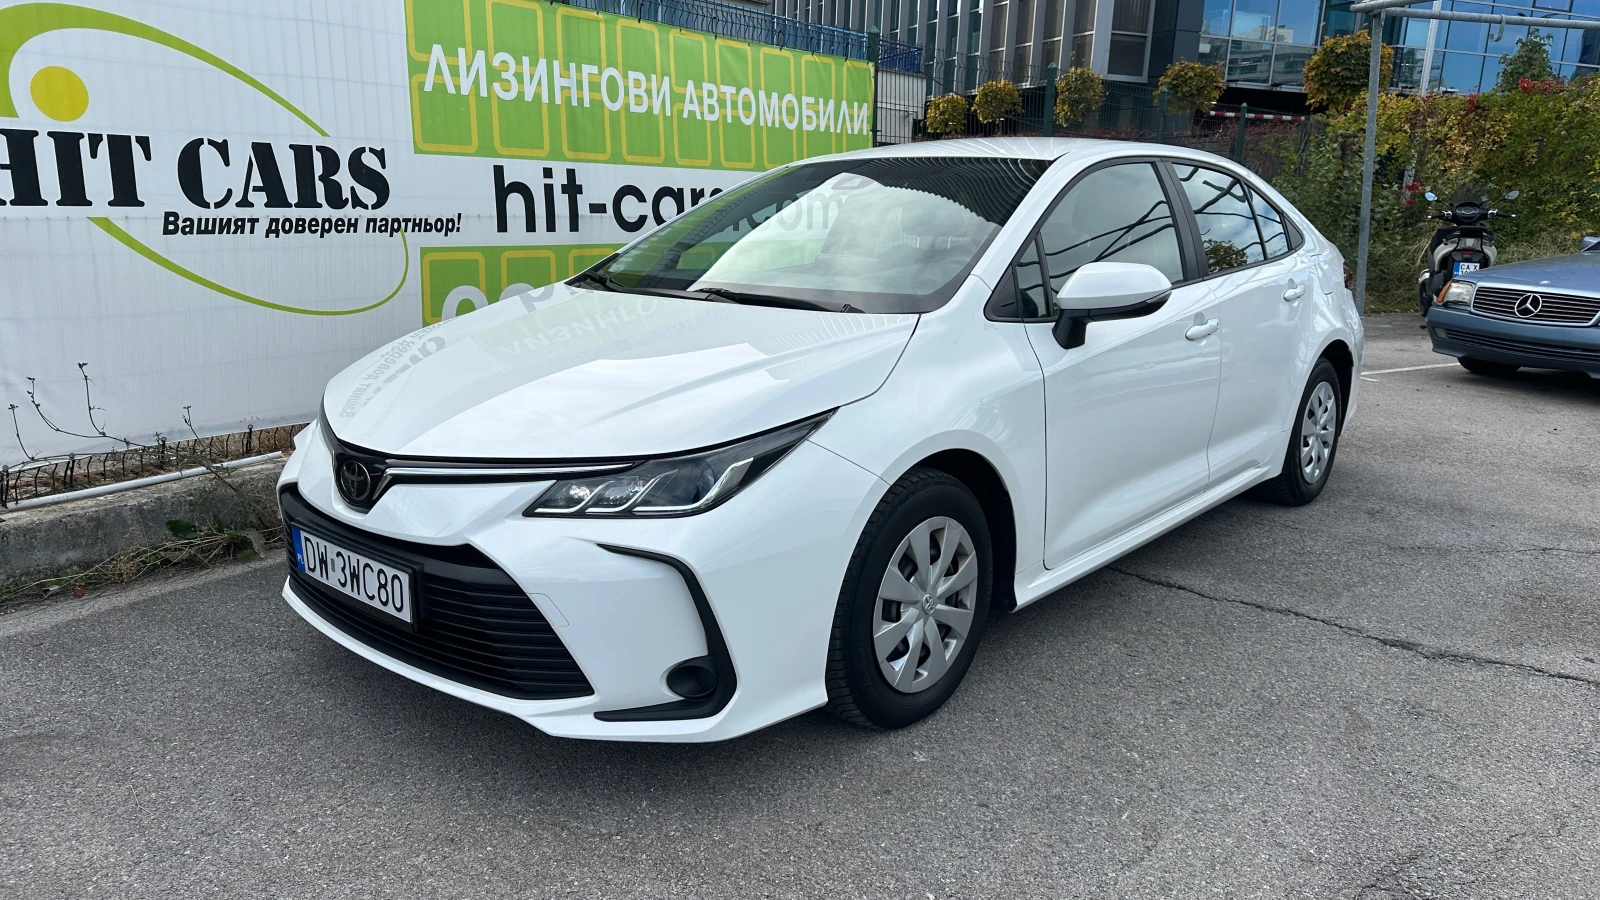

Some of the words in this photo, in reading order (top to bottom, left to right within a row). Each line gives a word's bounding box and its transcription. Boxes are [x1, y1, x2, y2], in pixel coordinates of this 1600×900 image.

[423, 44, 671, 118] ЛИЗИНГОВИ
[682, 80, 868, 136] АВТОМОБИЛИ
[177, 137, 391, 211] CARS
[162, 211, 260, 236] Вашият
[265, 214, 360, 239] доверен
[365, 213, 462, 238] партньор!
[304, 536, 329, 581] DW
[335, 550, 404, 613] 3WC80
